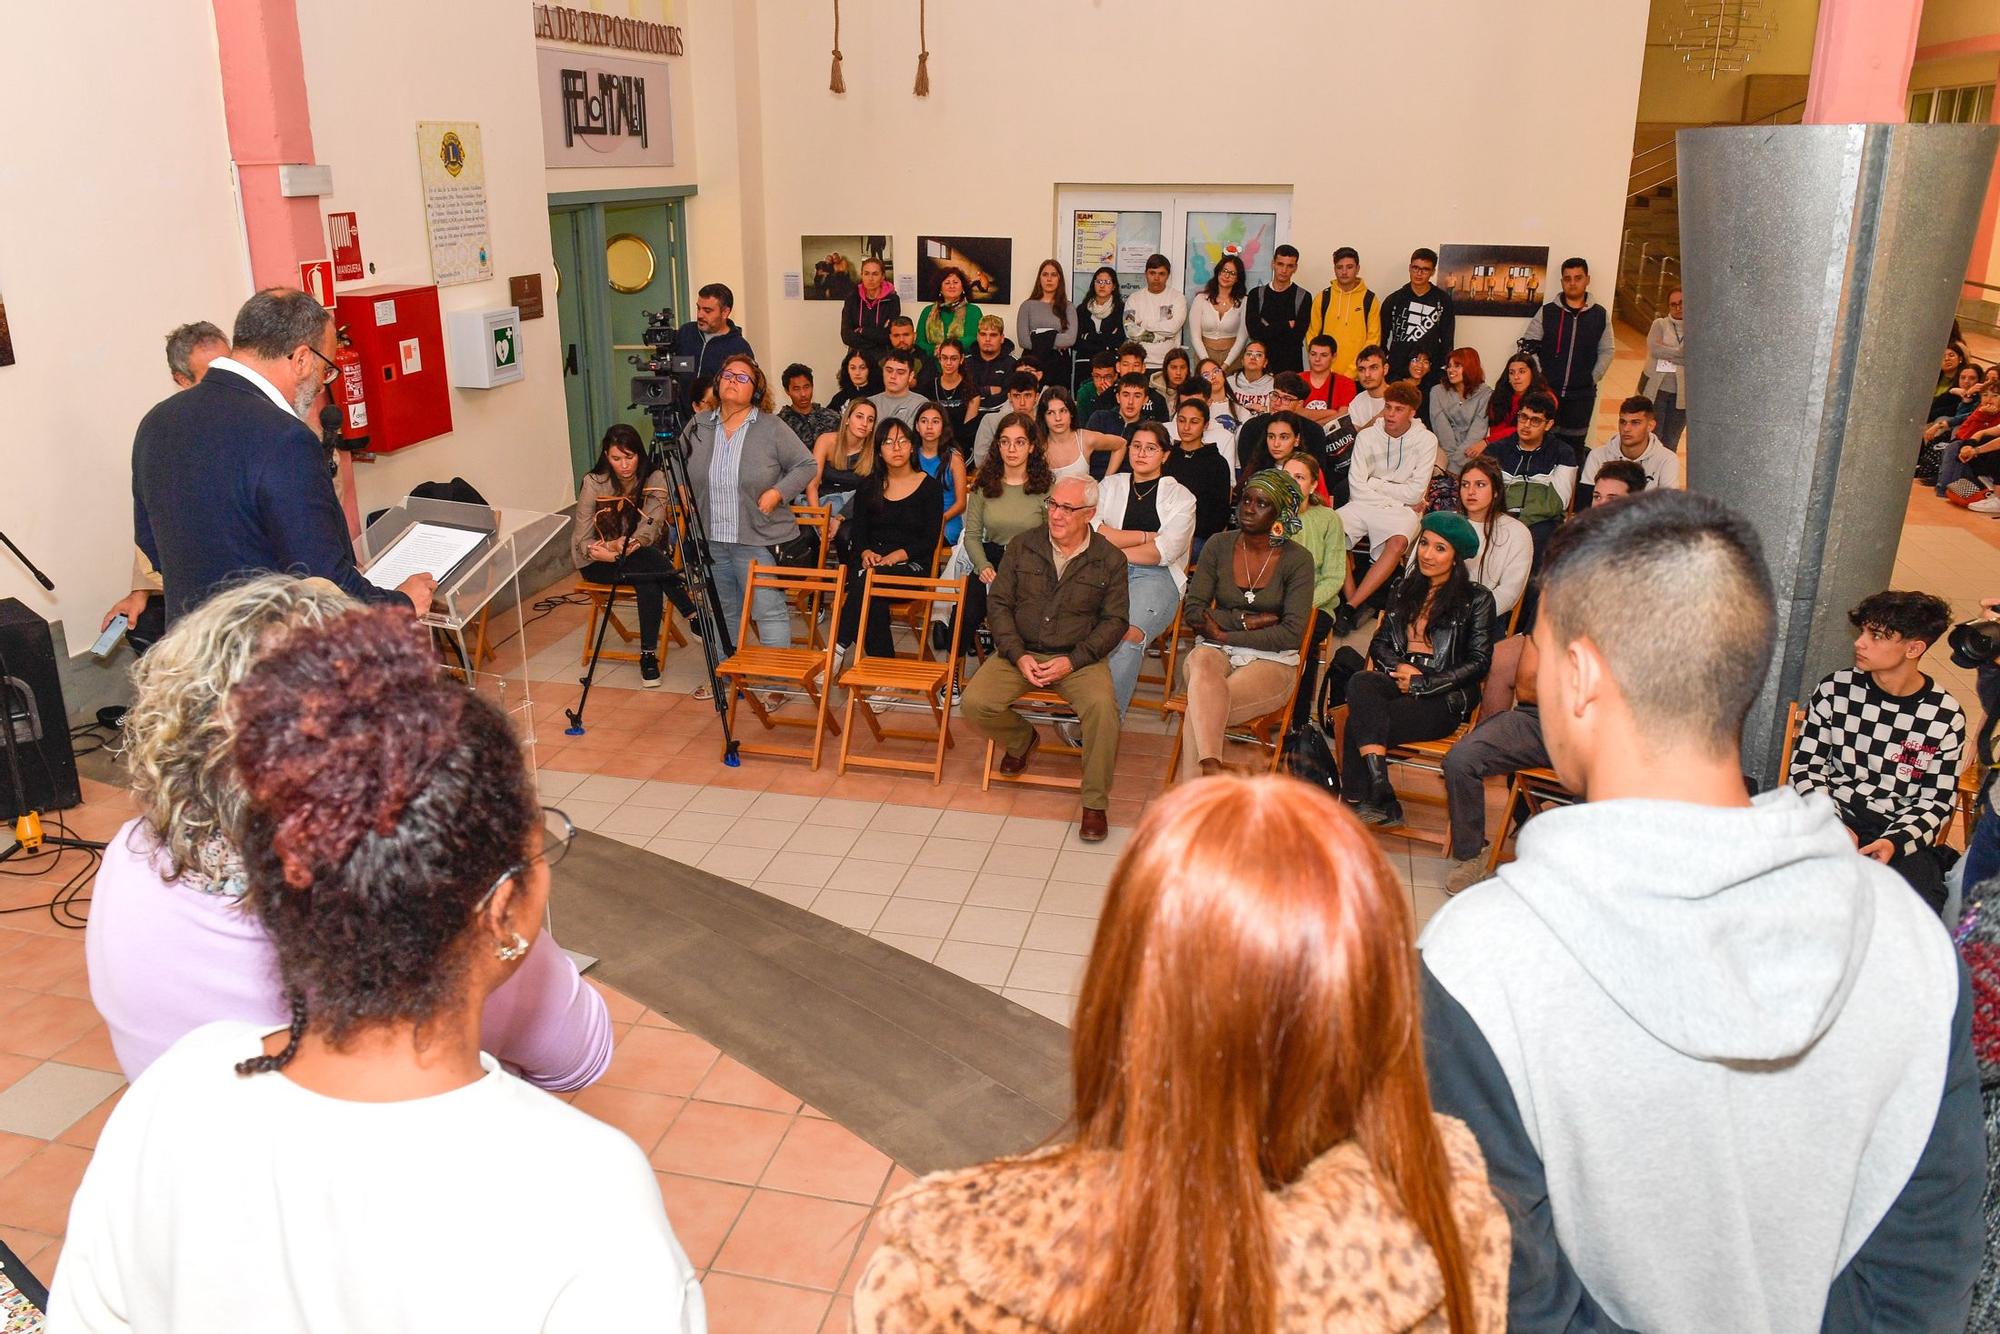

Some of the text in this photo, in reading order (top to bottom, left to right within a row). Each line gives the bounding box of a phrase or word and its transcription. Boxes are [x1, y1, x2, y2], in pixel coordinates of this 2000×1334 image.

[556, 5, 578, 42] DE
[580, 10, 684, 57] EXPOSICIONES
[336, 263, 363, 275] MANGUERA
